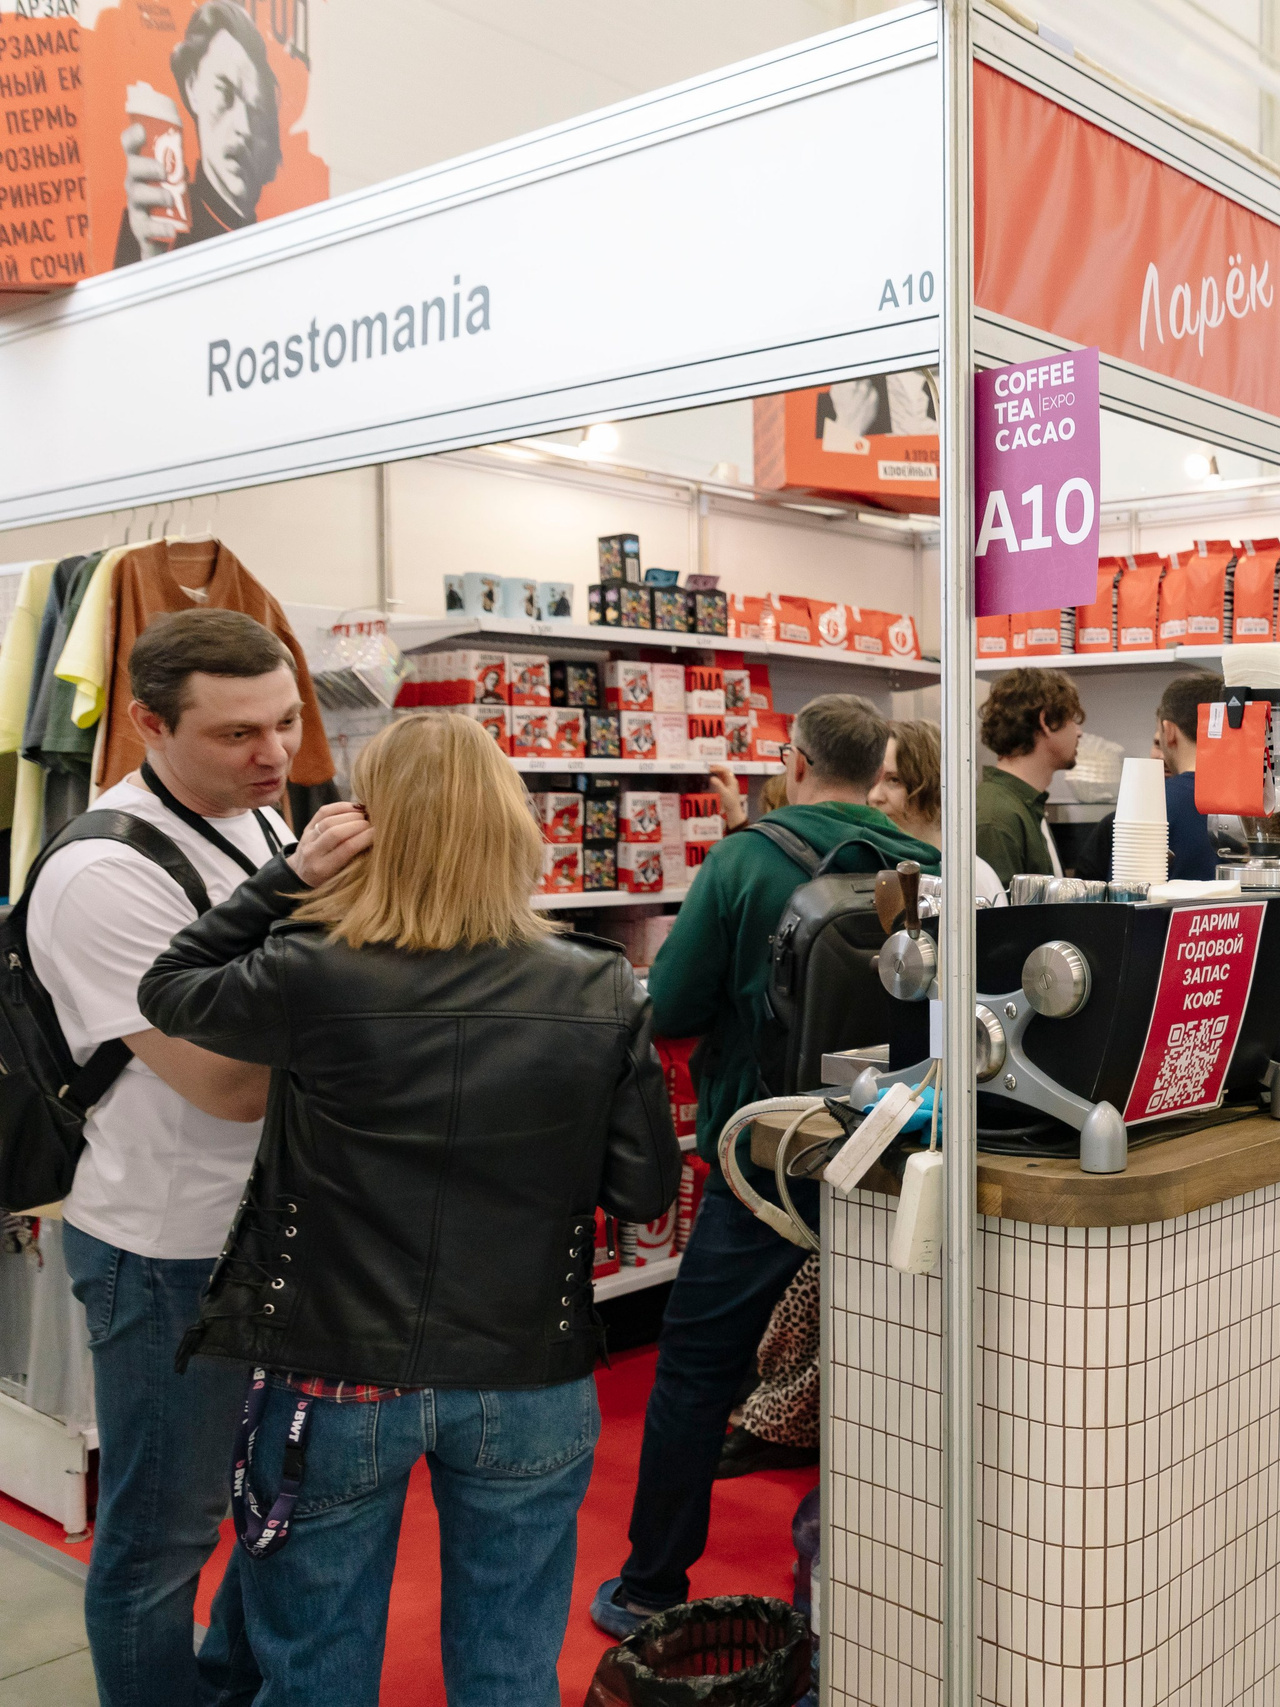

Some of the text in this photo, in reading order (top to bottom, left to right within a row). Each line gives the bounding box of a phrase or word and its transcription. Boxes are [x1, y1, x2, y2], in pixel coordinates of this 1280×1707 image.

[5, 105, 77, 135] ПЕРМЬ
[30, 251, 86, 281] СОЧИ
[878, 270, 935, 312] A10
[1139, 252, 1274, 357] Ларёк
[208, 274, 491, 397] Roastomania
[994, 359, 1075, 398] COFFEE
[994, 391, 1075, 425] TEA EXPO
[995, 417, 1076, 452] CACAO
[974, 477, 1095, 557] A10
[1188, 912, 1240, 937] ДАРИМ
[1177, 933, 1244, 962] ГОДОВОЙ
[1182, 963, 1231, 986] ЗАПАС
[1183, 988, 1223, 1010] КОФЕ
[288, 1410, 306, 1443] BWT
